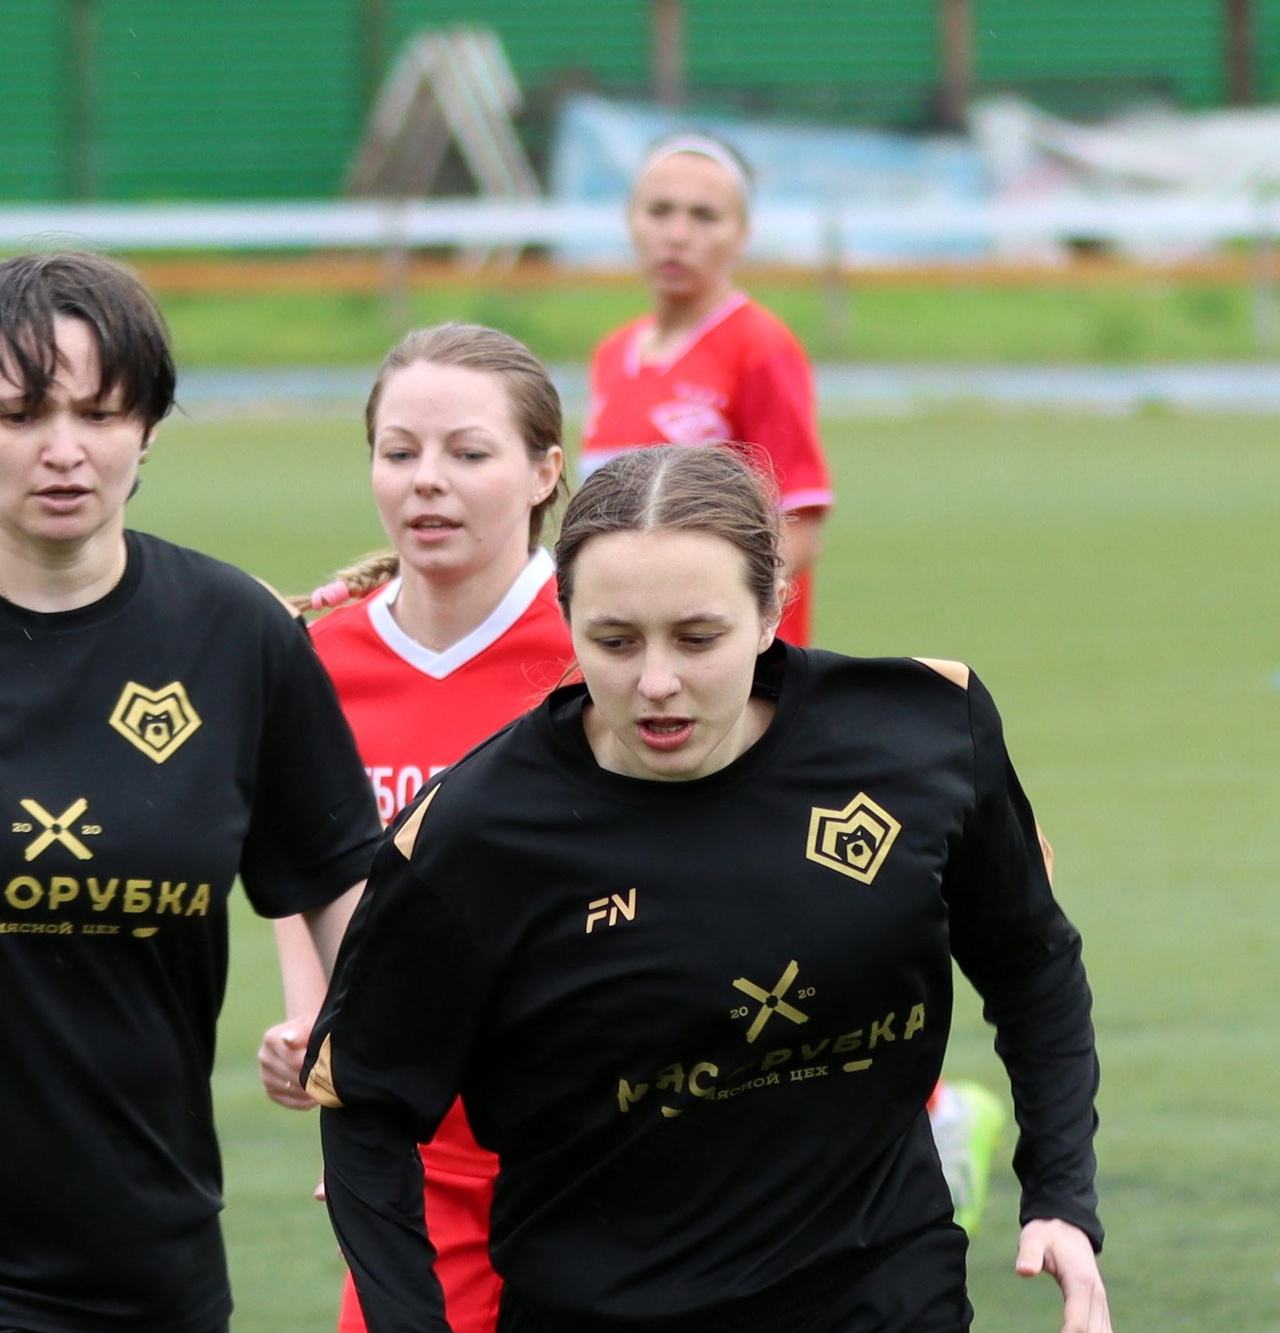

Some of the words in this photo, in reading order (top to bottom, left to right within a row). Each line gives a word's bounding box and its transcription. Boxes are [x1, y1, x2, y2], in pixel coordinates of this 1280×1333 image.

[363, 764, 448, 820] БО
[11, 822, 33, 833] 20
[81, 825, 102, 835] 20
[585, 888, 636, 934] FN
[81, 924, 120, 935] ЦЕХ
[730, 1006, 749, 1020] 20
[798, 987, 816, 1000] 20
[789, 1065, 829, 1083] ЦЕХ
